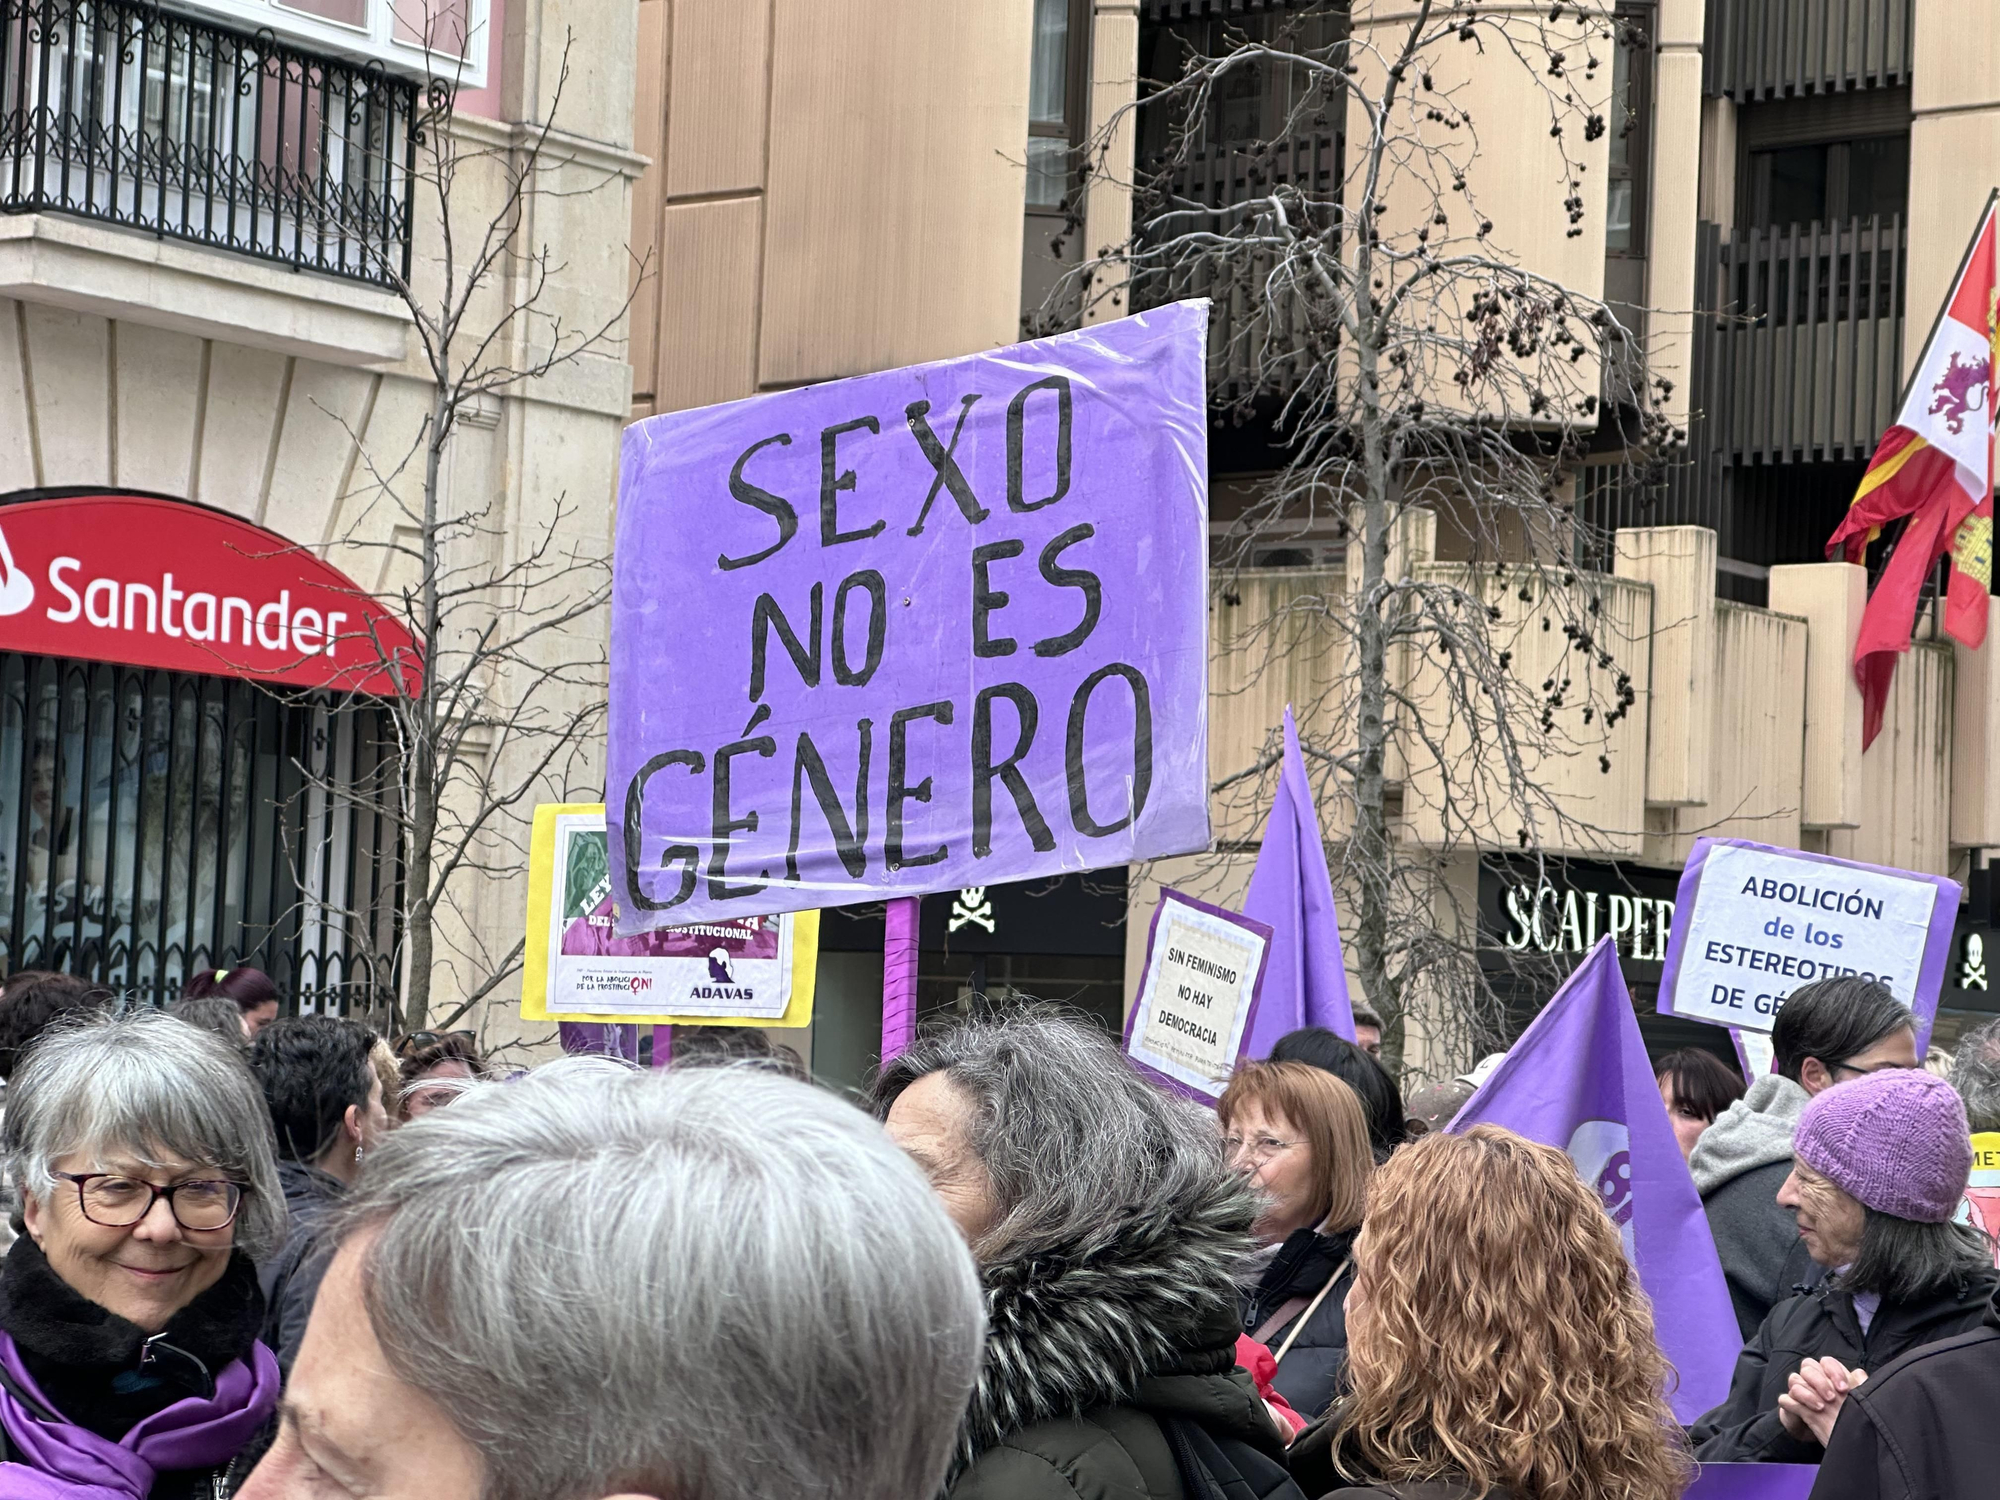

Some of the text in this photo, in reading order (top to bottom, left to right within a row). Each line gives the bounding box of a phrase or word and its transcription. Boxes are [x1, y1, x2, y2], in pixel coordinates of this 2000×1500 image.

[718, 375, 1072, 571] SEXO
[46, 556, 347, 657] Santander
[749, 522, 1102, 703] NO ES
[623, 662, 1154, 913] GÉNERO
[1741, 876, 1885, 920] ABOLICIÓN
[588, 915, 611, 927] DEL
[1763, 916, 1844, 950] de los
[1168, 947, 1237, 985] SIN FEMINISMO
[689, 987, 754, 1000] ADAVAS
[1177, 984, 1213, 1010] NO HAY
[1710, 984, 1746, 1009] DE
[1158, 1009, 1218, 1047] DEMOCRACIA
